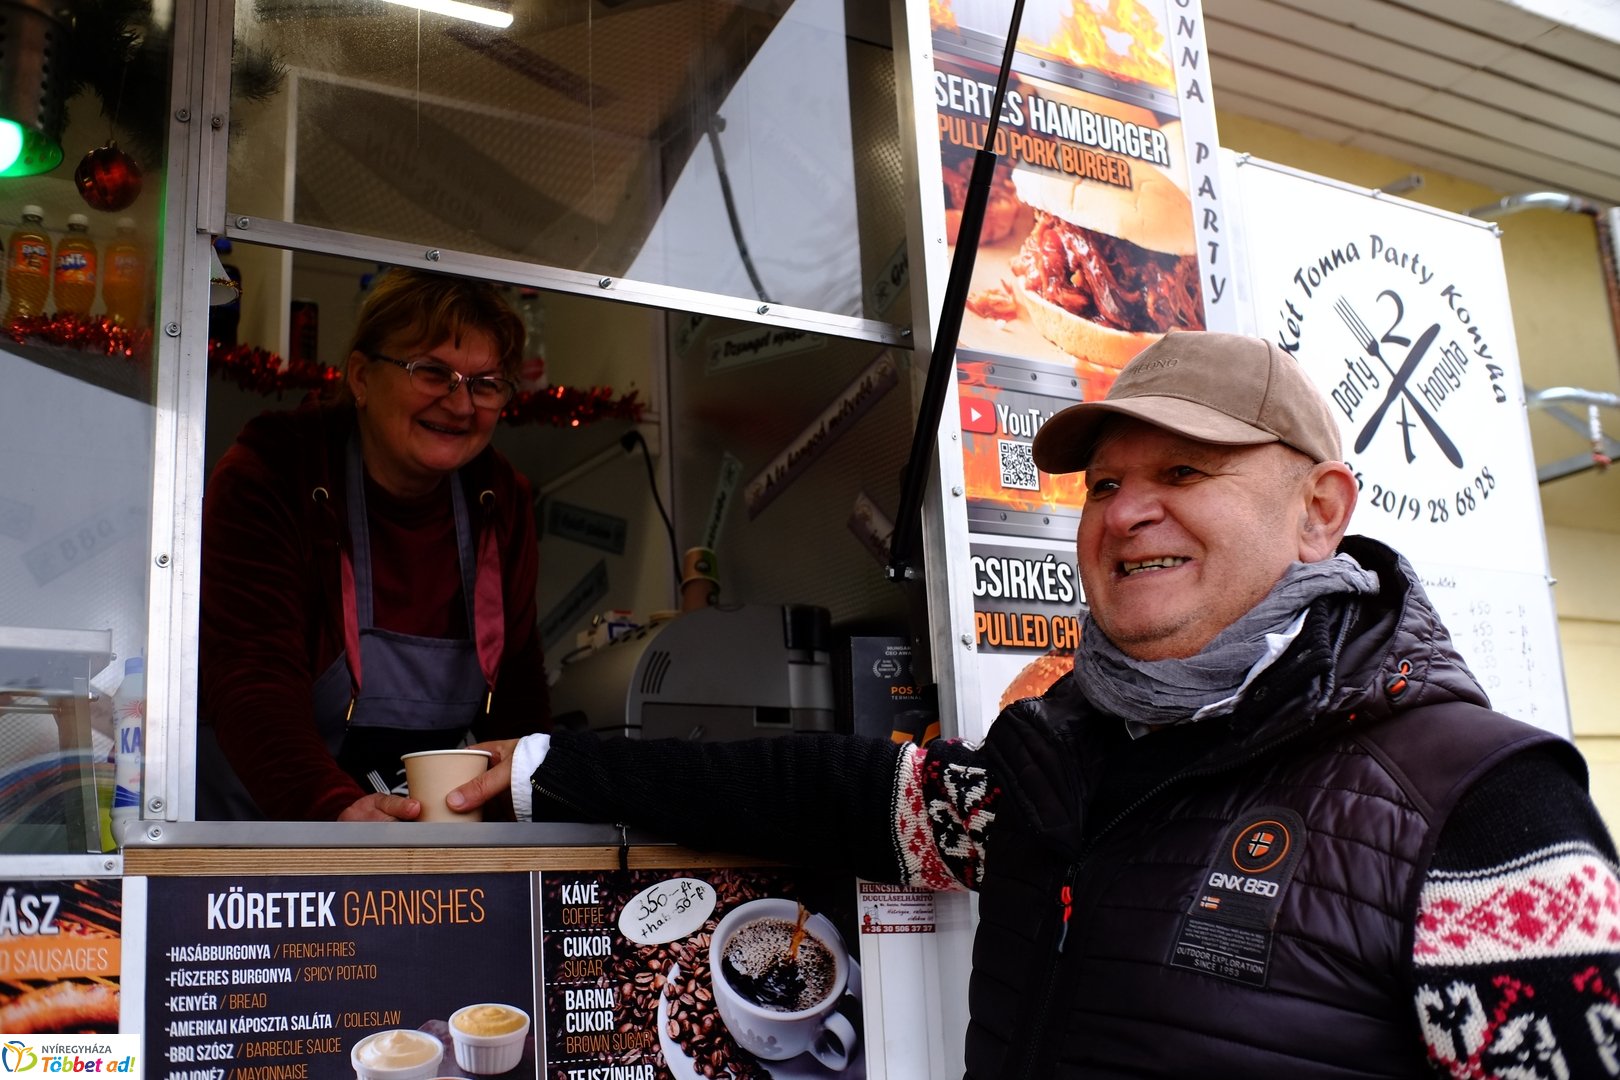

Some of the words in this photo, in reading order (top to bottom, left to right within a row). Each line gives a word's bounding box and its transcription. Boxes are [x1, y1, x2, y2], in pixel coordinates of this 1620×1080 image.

[1028, 95, 1170, 167] HAMBURGER
[1009, 131, 1061, 171] PORK
[1062, 143, 1133, 190] BURGER
[1293, 242, 1361, 299] Tonna
[1369, 234, 1434, 285] Party
[1376, 289, 1412, 348] 2
[1331, 356, 1380, 423] party
[1416, 340, 1469, 412] konyha
[1427, 498, 1449, 524] 28
[1455, 486, 1476, 517] 68
[1475, 466, 1496, 500] 28
[971, 554, 1074, 604] CSIRKÉS
[974, 611, 1048, 649] PULLED
[891, 687, 913, 695] POS
[561, 883, 600, 905] KÁVÉ
[862, 884, 901, 893] HUNCSIK
[1208, 872, 1245, 891] GNX
[1243, 878, 1280, 898] 850
[207, 886, 337, 930] KÖRETEK
[343, 888, 486, 928] GARNISHES
[562, 906, 605, 925] COFFEE
[866, 925, 882, 933] +36
[883, 925, 894, 933] 30
[895, 925, 910, 933] 506
[911, 925, 921, 933] 37
[923, 925, 933, 933] 37
[282, 943, 326, 960] FRENCH
[326, 941, 356, 958] FRIES
[563, 936, 612, 957] CUKOR
[13, 947, 109, 976] SAUSAGES
[564, 959, 604, 979] SUGAR
[1176, 947, 1212, 963] OUTDOOR
[1211, 953, 1265, 974] EXPLORATION
[1194, 958, 1216, 972] SINCE
[1219, 963, 1240, 978] 1953
[231, 966, 292, 985] BURGONYA
[303, 965, 334, 982] SPICY
[336, 964, 377, 981] POTATO
[229, 993, 267, 1010] BREAD
[565, 987, 615, 1011] BARNA
[230, 1014, 289, 1034] KÁPOSZTA
[290, 1012, 332, 1031] SALÁTA
[343, 1010, 401, 1028] COLESLAW
[565, 1010, 615, 1033] CUKOR
[196, 1042, 234, 1061] SZÓSZ
[246, 1039, 304, 1059] BARBECUE
[306, 1037, 342, 1055] SAUCE
[566, 1034, 611, 1054] BROWN
[612, 1030, 653, 1051] SUGAR
[237, 1063, 309, 1080] MAYONNAISE
